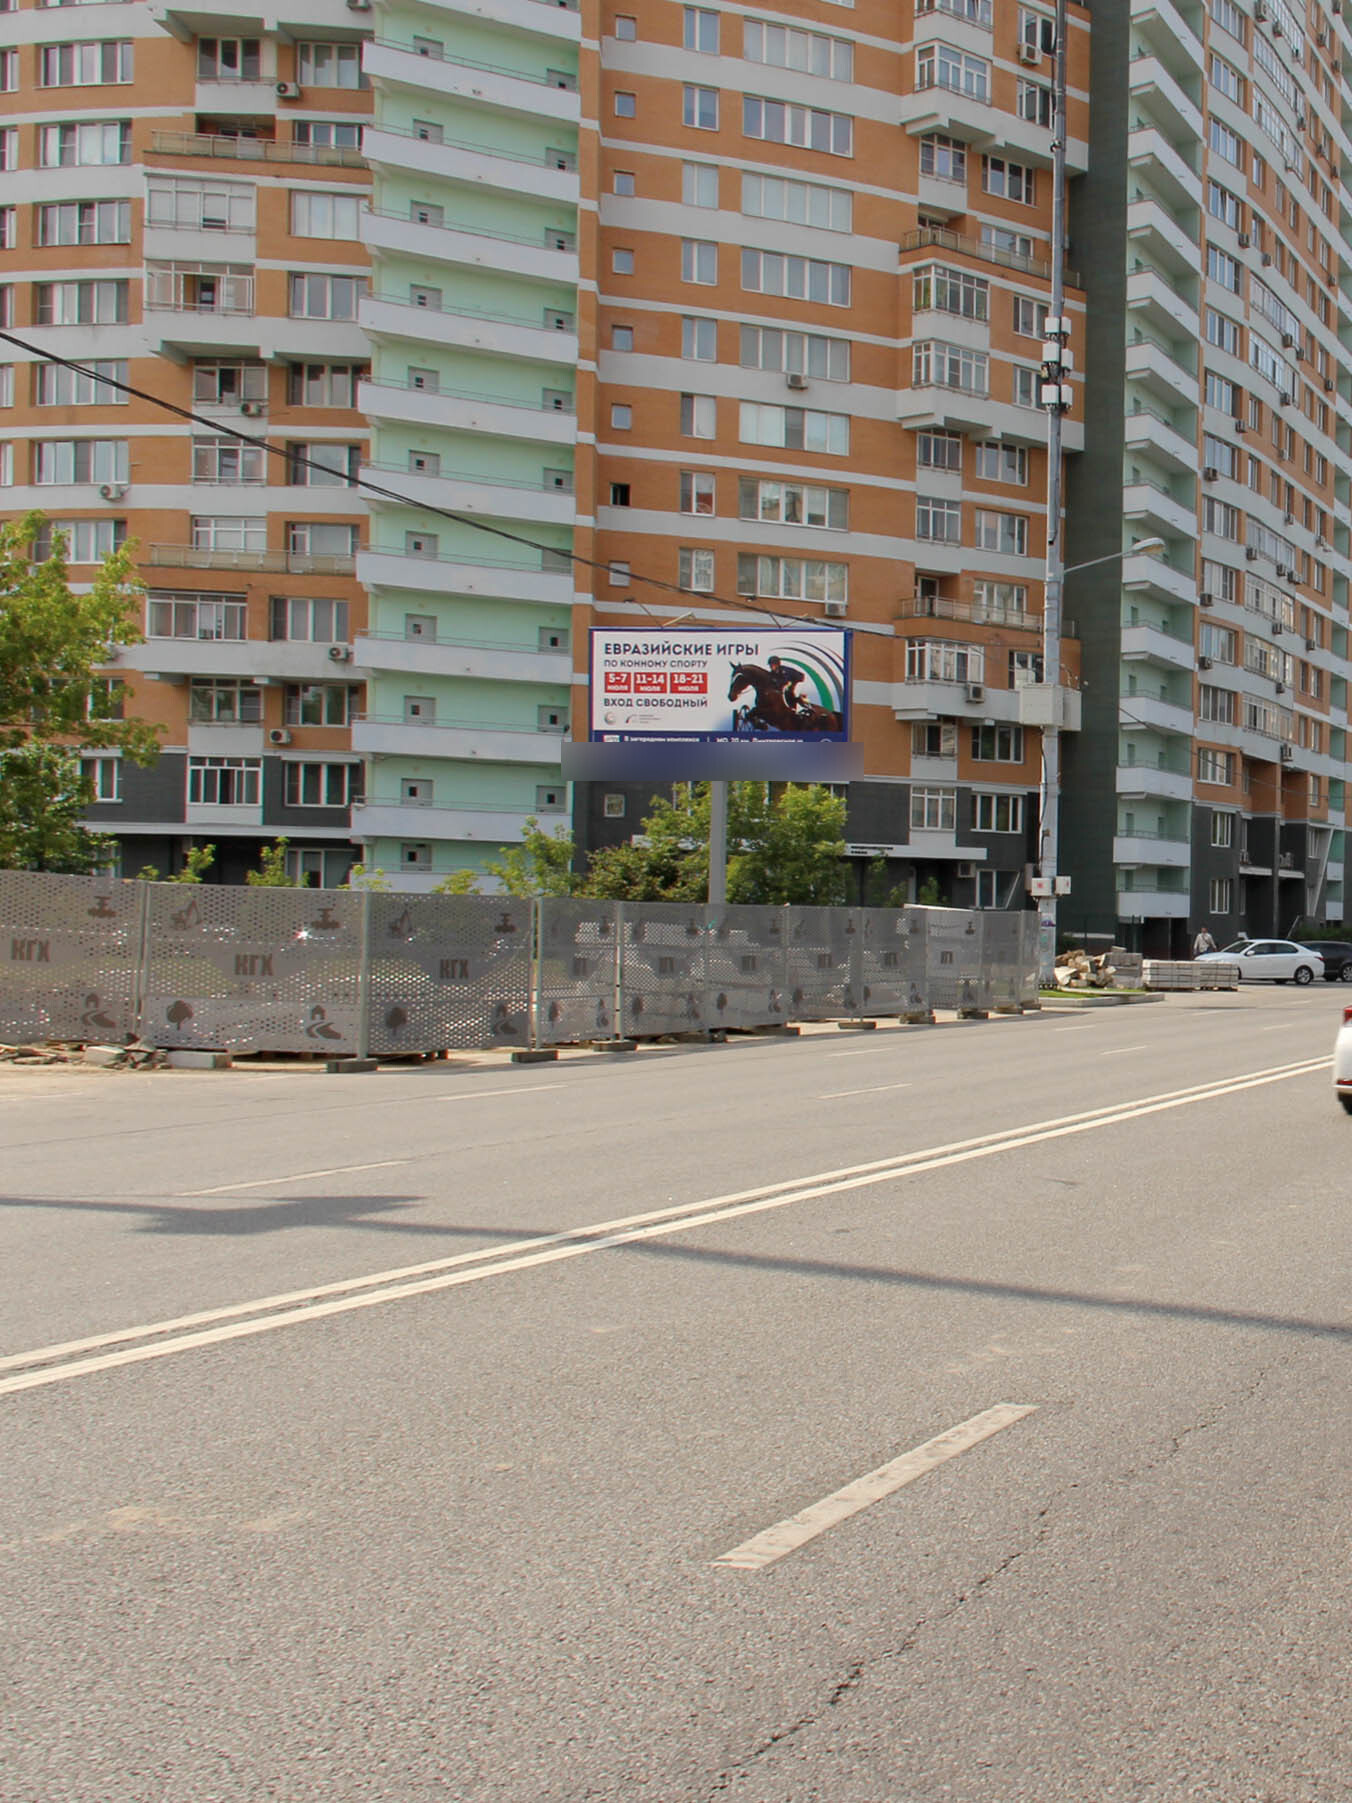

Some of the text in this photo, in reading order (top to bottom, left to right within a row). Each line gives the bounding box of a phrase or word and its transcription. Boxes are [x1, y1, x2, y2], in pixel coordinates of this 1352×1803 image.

[604, 641, 759, 656] ЕВРАЗИЙСКИЕ ИГРЫ
[604, 659, 708, 668] ПО КОННОМУ СПОРТУ
[608, 674, 628, 684] 5-7
[635, 674, 665, 685] 11-14
[673, 674, 704, 685] 18-21
[604, 696, 708, 708] ВХОД СВОБОДНЫЙ
[11, 938, 50, 962] КГХ
[235, 953, 273, 976] КГХ
[440, 958, 469, 980] КГХ
